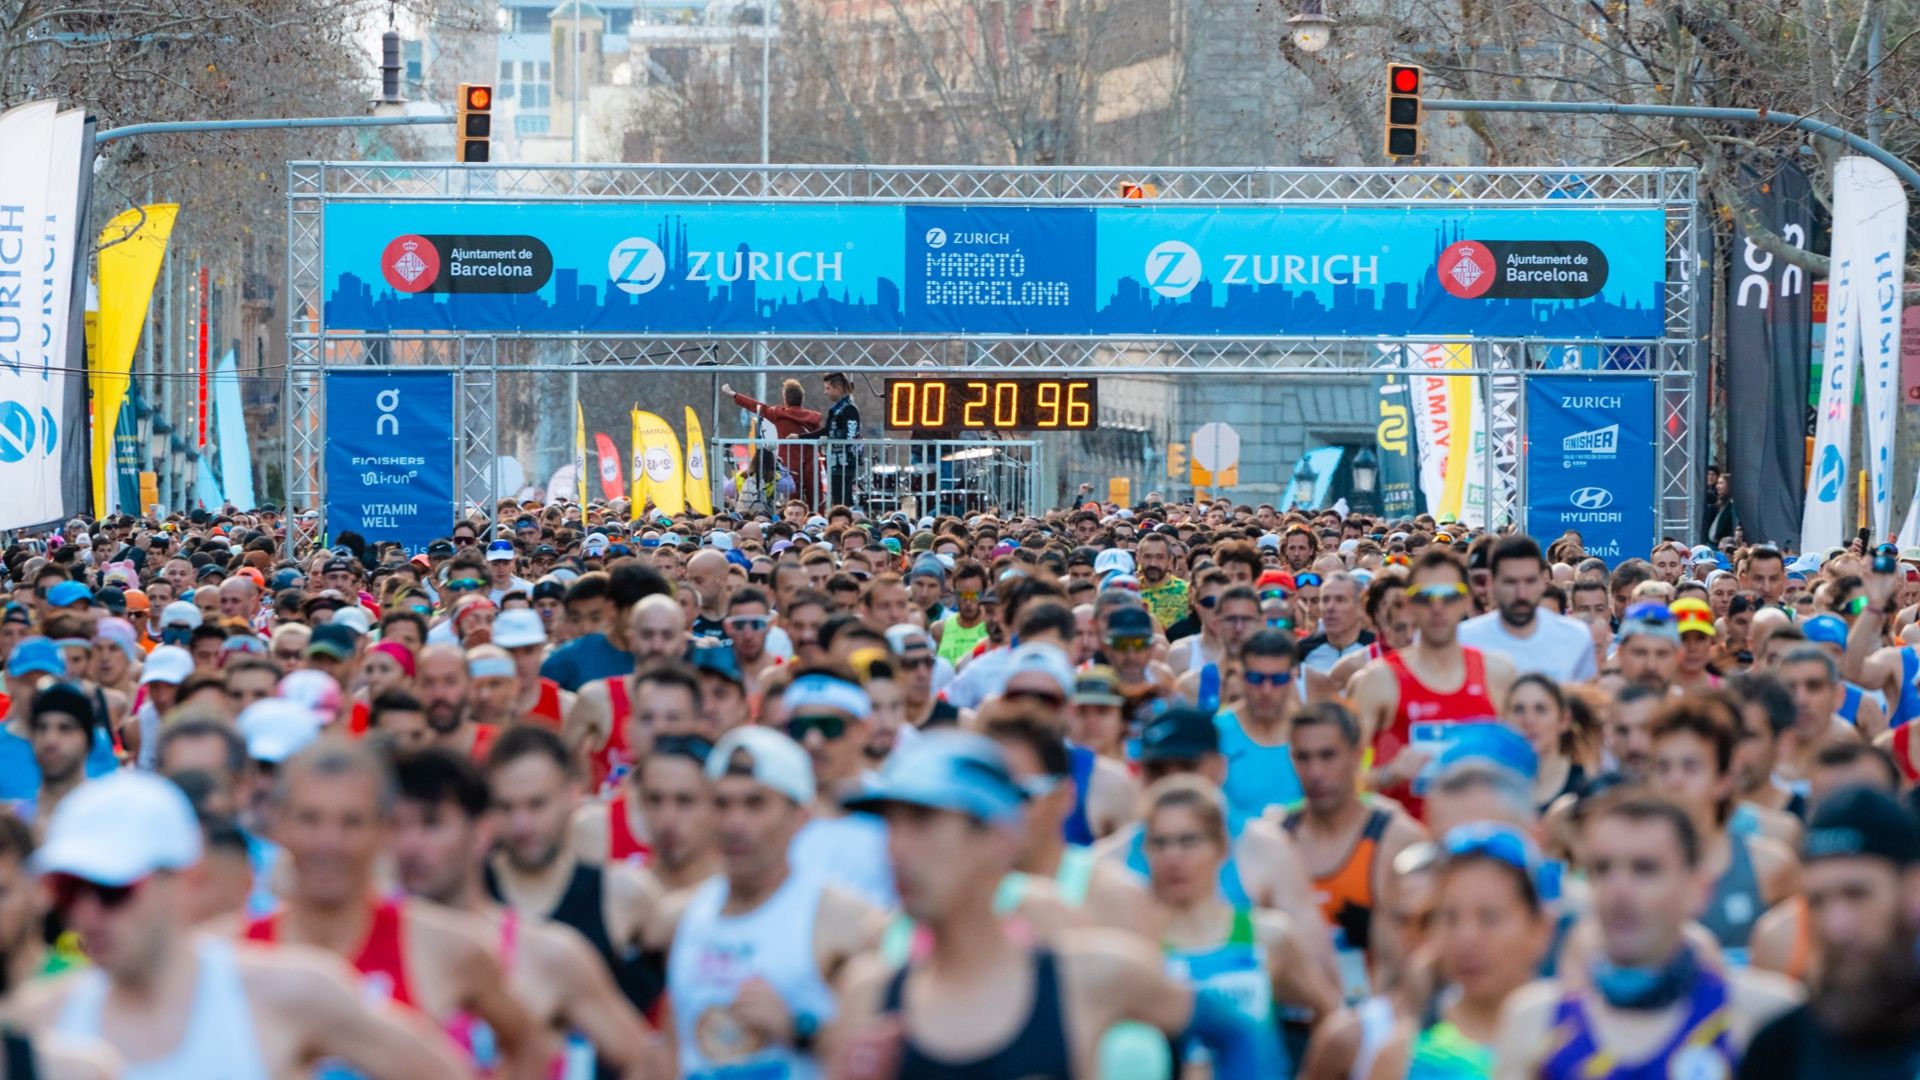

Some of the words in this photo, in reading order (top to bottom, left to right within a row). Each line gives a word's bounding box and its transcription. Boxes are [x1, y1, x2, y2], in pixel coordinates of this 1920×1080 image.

[953, 232, 1009, 244] ZURICH
[451, 248, 516, 261] Ajuntament
[518, 249, 533, 259] de
[1507, 254, 1572, 267] Ajuntament
[1573, 254, 1589, 265] de
[451, 262, 533, 276] Barcelona
[685, 250, 843, 282] ZURICH
[926, 248, 1025, 277] MARATÓ
[1222, 254, 1378, 285] ZURICH
[1507, 267, 1589, 282] Barcelona
[926, 281, 1069, 306] BARCELONA
[891, 383, 945, 426] 00
[964, 383, 1018, 426] 20
[1037, 383, 1089, 426] 96
[1562, 396, 1621, 408] ZURICH
[1565, 430, 1614, 449] FINISHER
[352, 457, 425, 465] FINISHERS
[380, 472, 410, 484] i-run
[362, 504, 418, 515] VITAMIN
[362, 517, 399, 528] WELL
[1561, 513, 1622, 523] HYUNDAI
